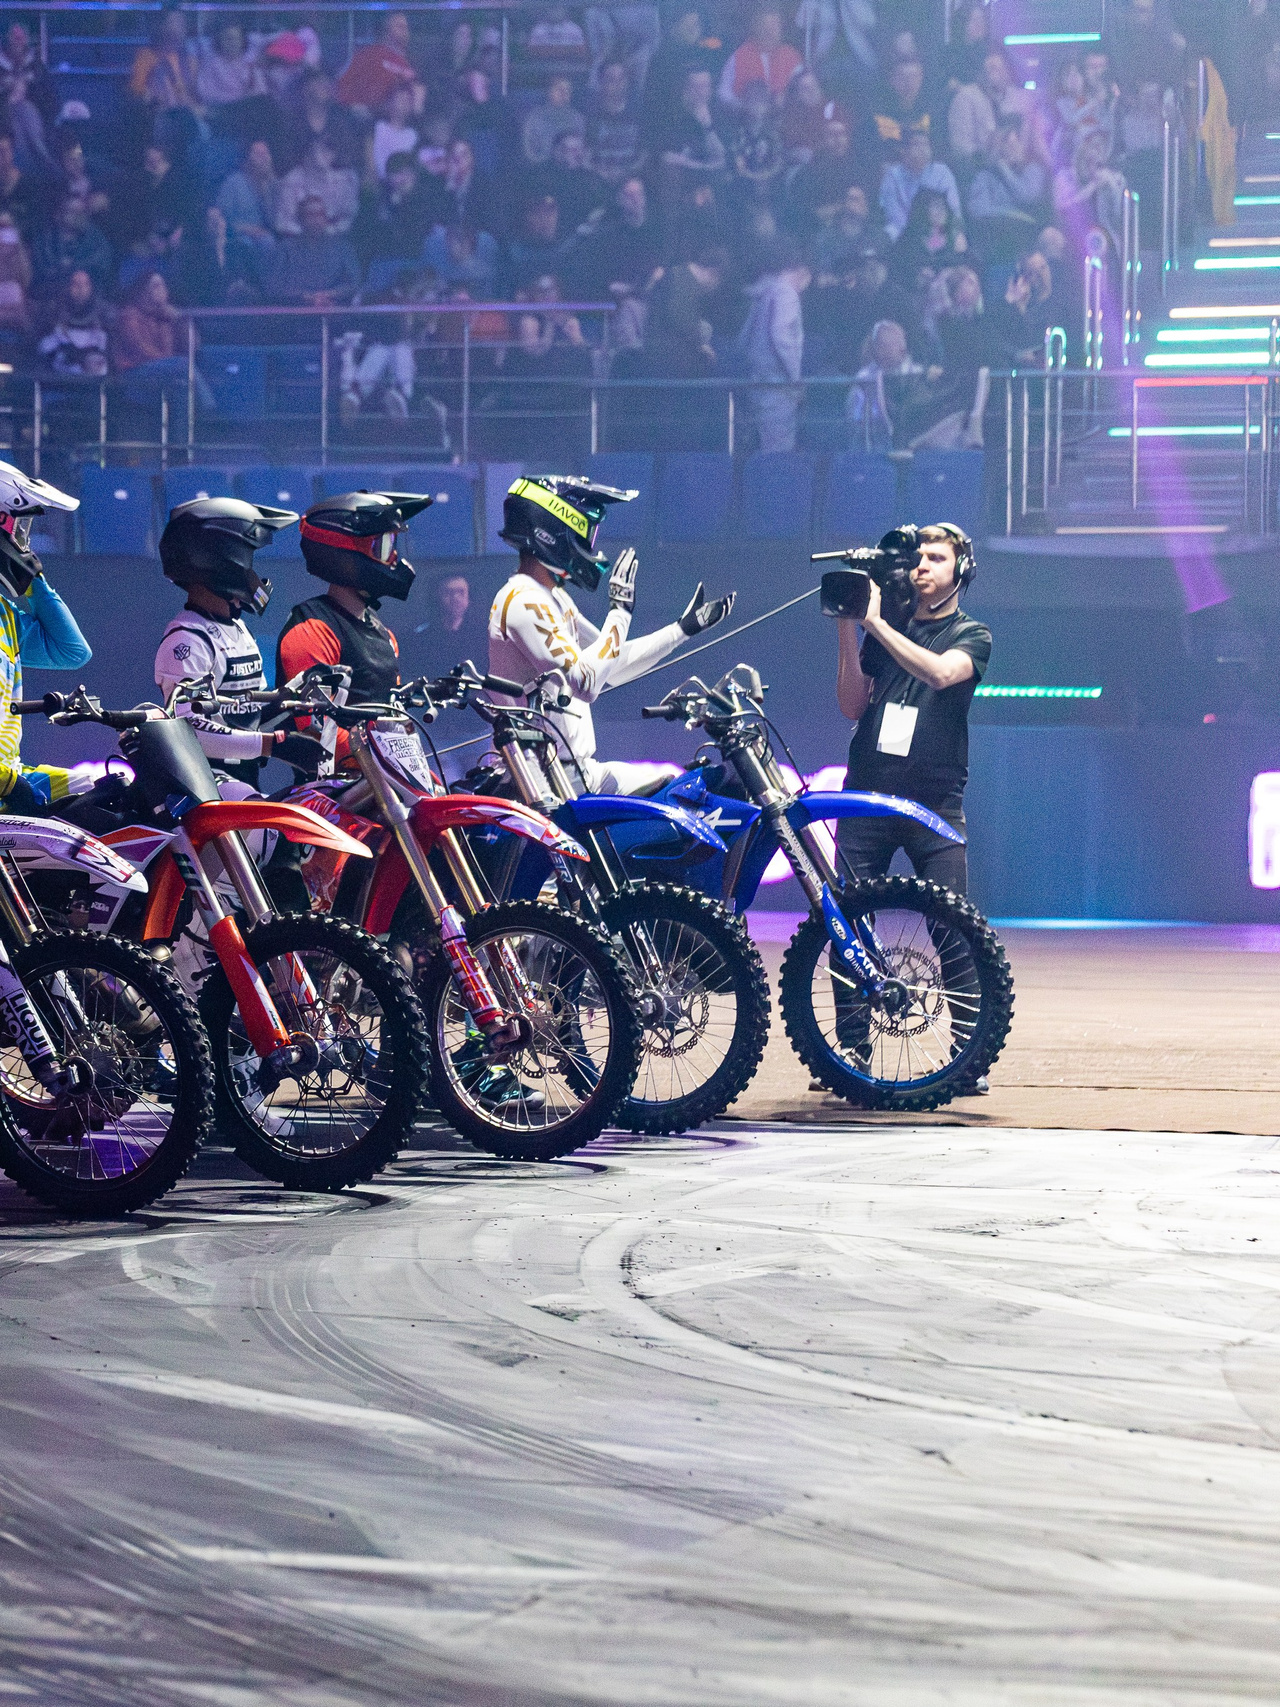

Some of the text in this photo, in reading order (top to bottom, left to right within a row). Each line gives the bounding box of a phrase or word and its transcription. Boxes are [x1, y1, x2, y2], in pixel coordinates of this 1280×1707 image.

[851, 939, 879, 978] FXR
[0, 1001, 38, 1057] MOLY
[9, 992, 49, 1051] LIQUI
